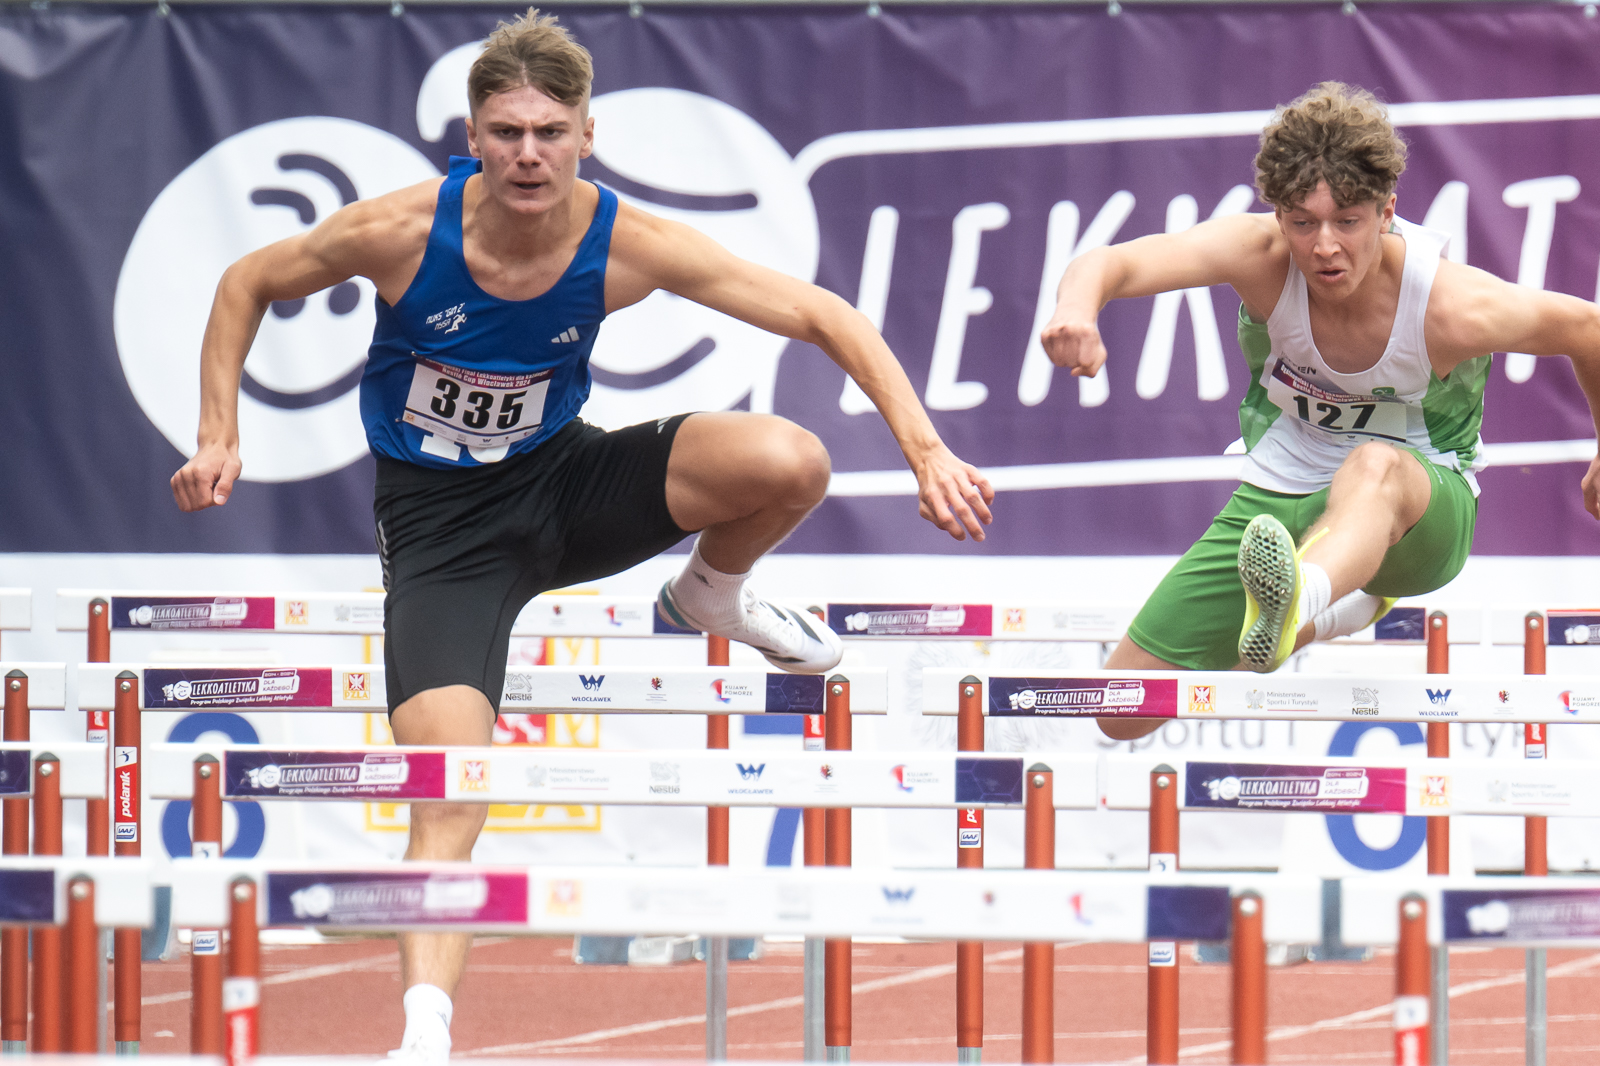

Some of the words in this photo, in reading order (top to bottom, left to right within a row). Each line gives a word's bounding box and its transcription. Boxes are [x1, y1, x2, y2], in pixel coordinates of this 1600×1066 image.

[515, 379, 531, 388] 2024
[430, 377, 528, 430] 335
[1293, 394, 1376, 430] 127
[191, 679, 257, 697] LEKKOATLETYKA
[190, 698, 212, 707] Program
[212, 697, 235, 706] Polskiego
[235, 696, 256, 704] Związku
[256, 695, 273, 704] Lekkiej
[273, 694, 294, 702] Atletyki
[344, 691, 370, 700] PZLA
[571, 695, 612, 703] WŁOCŁAWEK
[1036, 689, 1102, 707] LEKKOATLETYKA
[1267, 691, 1306, 699] Ministerstwo
[1189, 704, 1214, 712] PZLA
[1291, 699, 1319, 707] Turystyki
[1034, 708, 1056, 716] Program
[1056, 707, 1080, 715] Polskiego
[1080, 707, 1100, 715] Związku
[1100, 707, 1118, 715] Lekkiej
[281, 765, 357, 783] LEKKOATLETYKA
[1241, 778, 1318, 796] LEKKOATLETYKA
[120, 771, 133, 818] polanik
